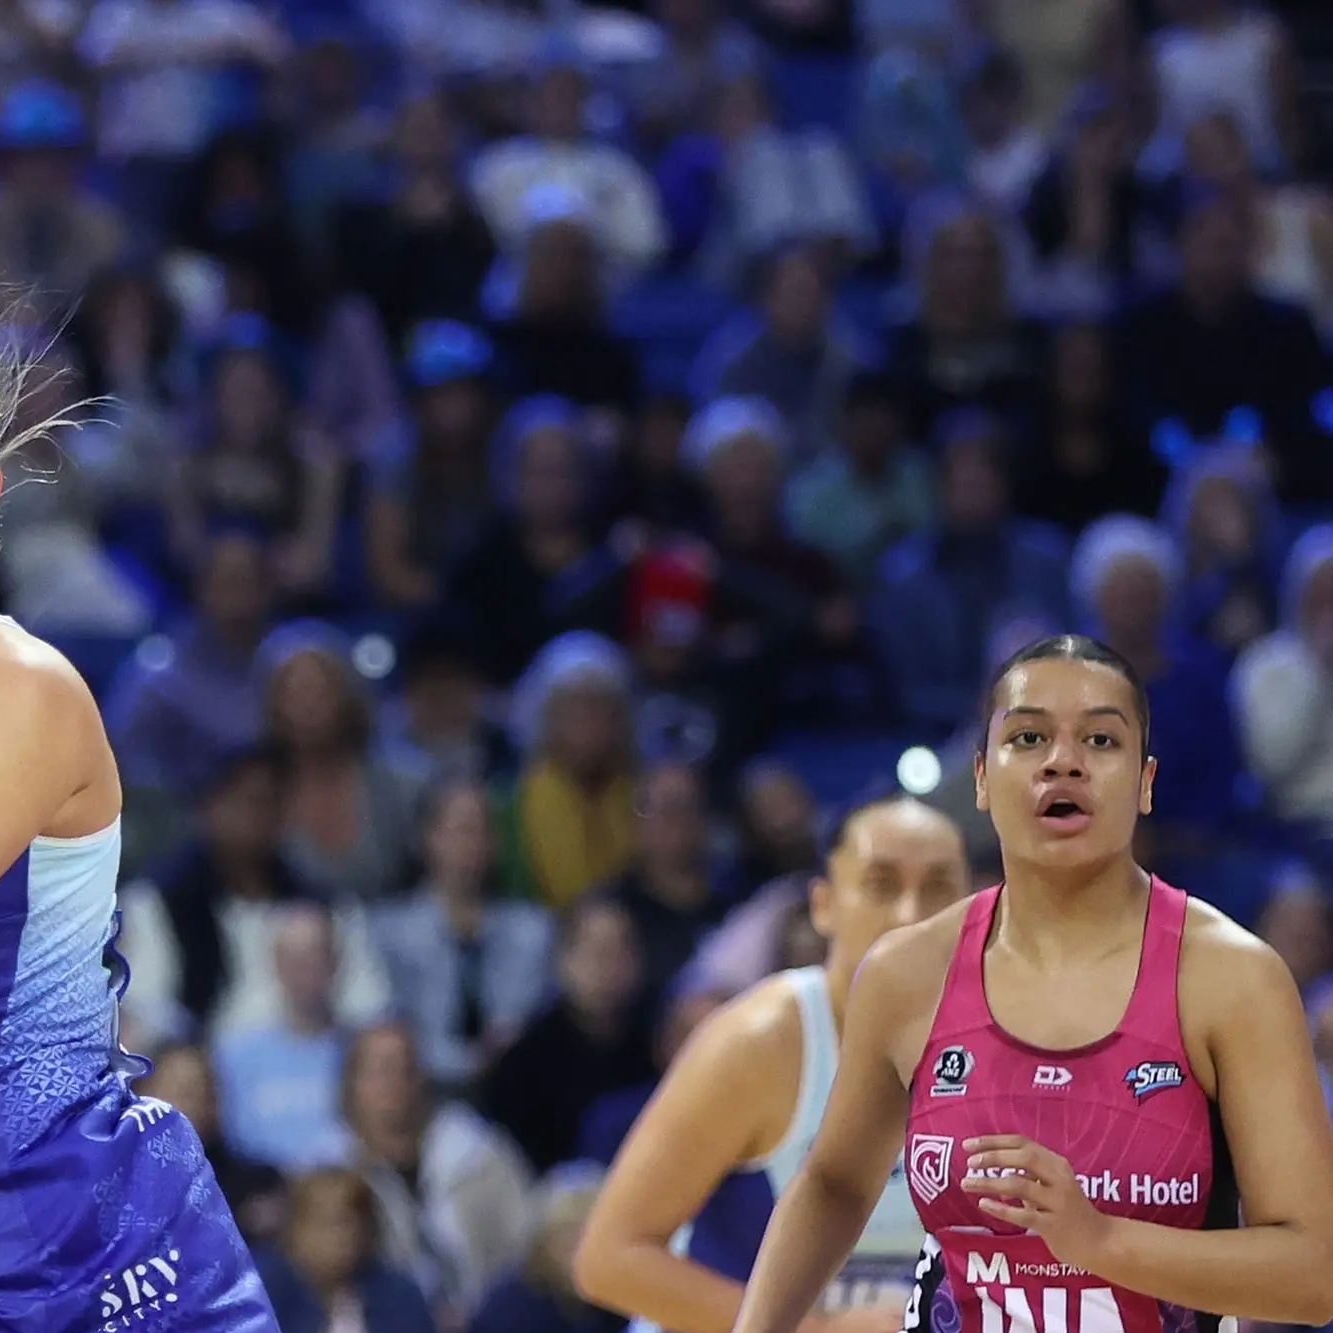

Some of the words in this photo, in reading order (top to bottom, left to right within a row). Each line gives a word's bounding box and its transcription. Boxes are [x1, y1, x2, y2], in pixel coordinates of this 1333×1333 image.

[1075, 1169, 1121, 1203] ark
[1130, 1173, 1199, 1206] Hotel
[100, 1249, 179, 1319] SKY
[1015, 1262, 1092, 1278] MONSTAV
[104, 1300, 162, 1333] CITY
